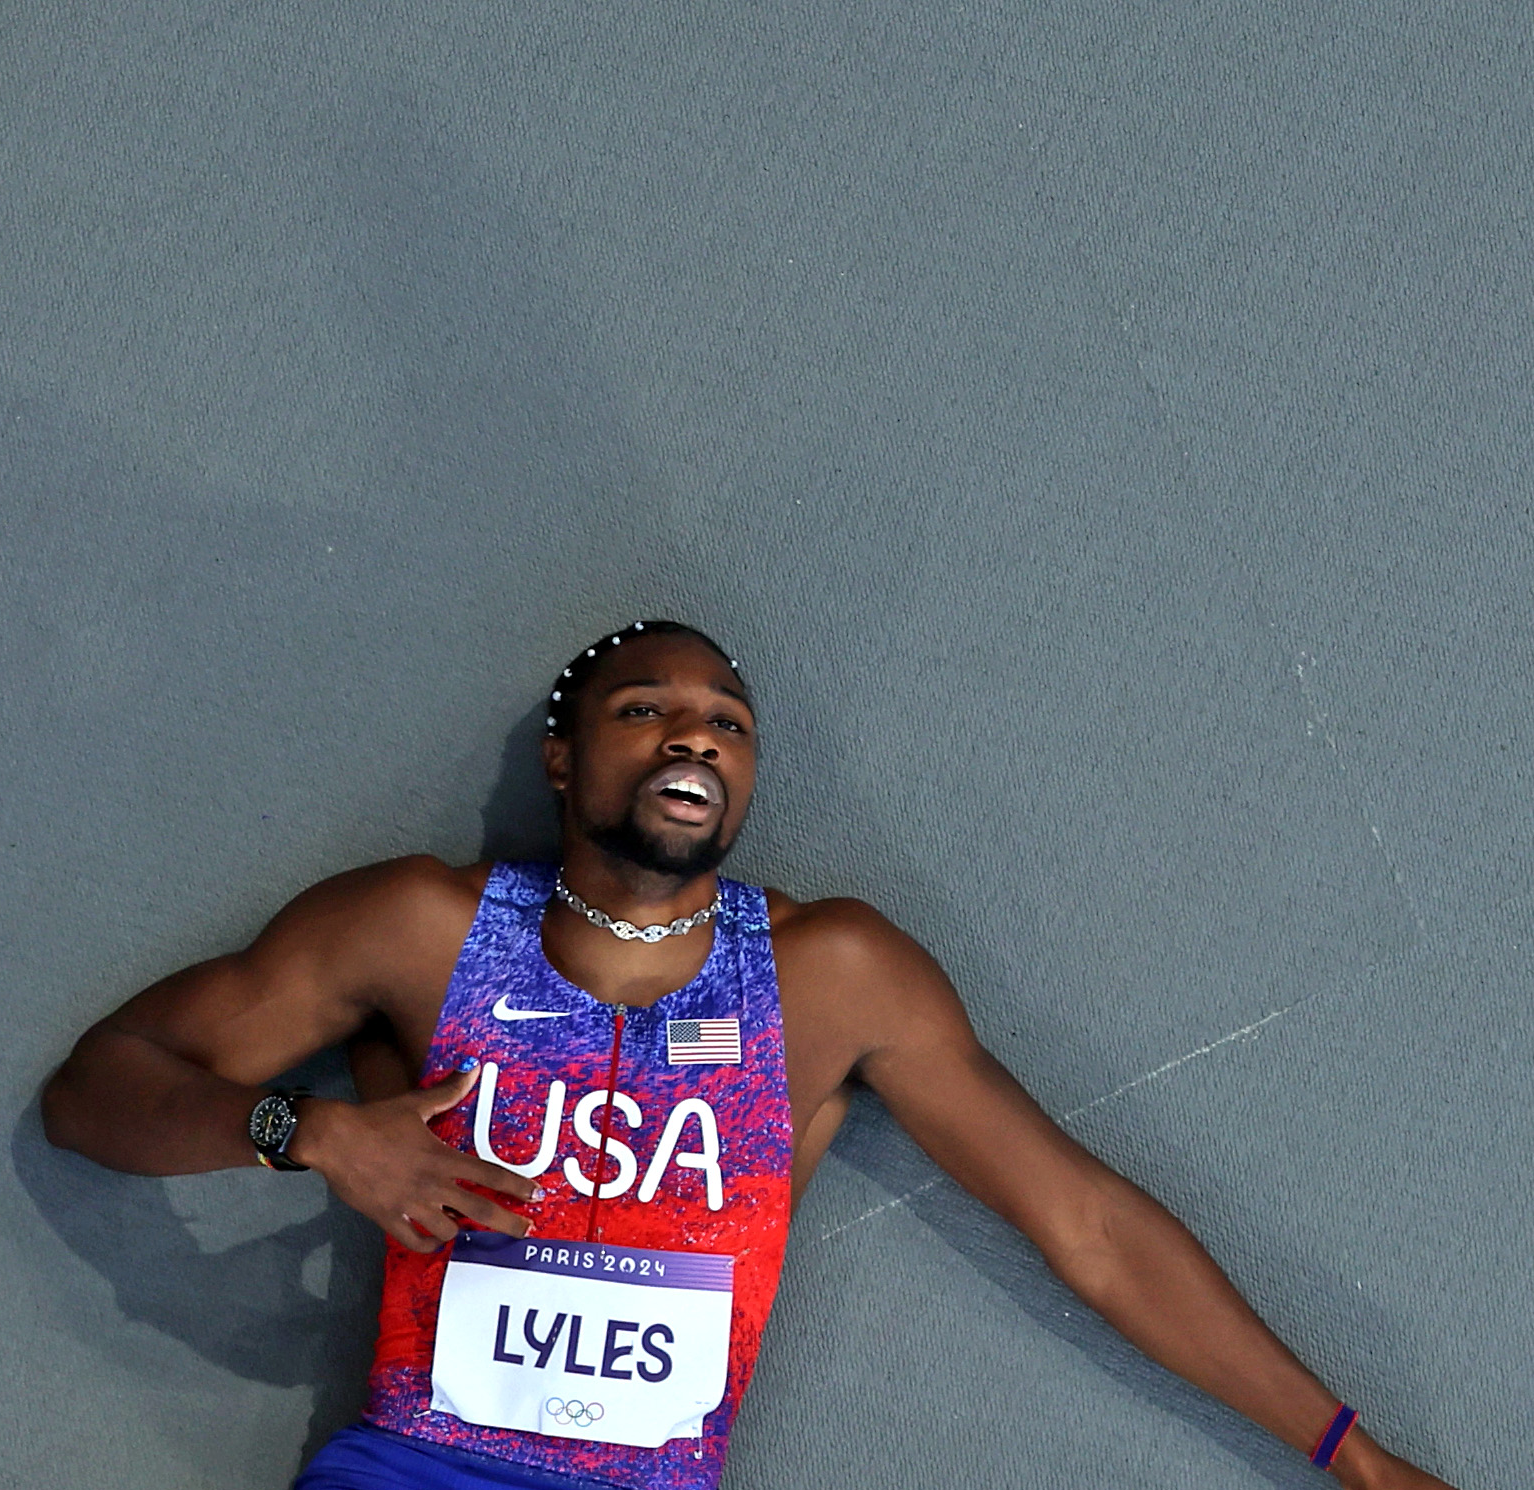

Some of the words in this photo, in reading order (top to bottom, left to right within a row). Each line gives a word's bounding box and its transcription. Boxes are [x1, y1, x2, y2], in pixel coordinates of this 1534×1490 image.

[474, 1062, 723, 1211] USA
[604, 1255, 665, 1277] 2024
[493, 1304, 675, 1383] LYLES
